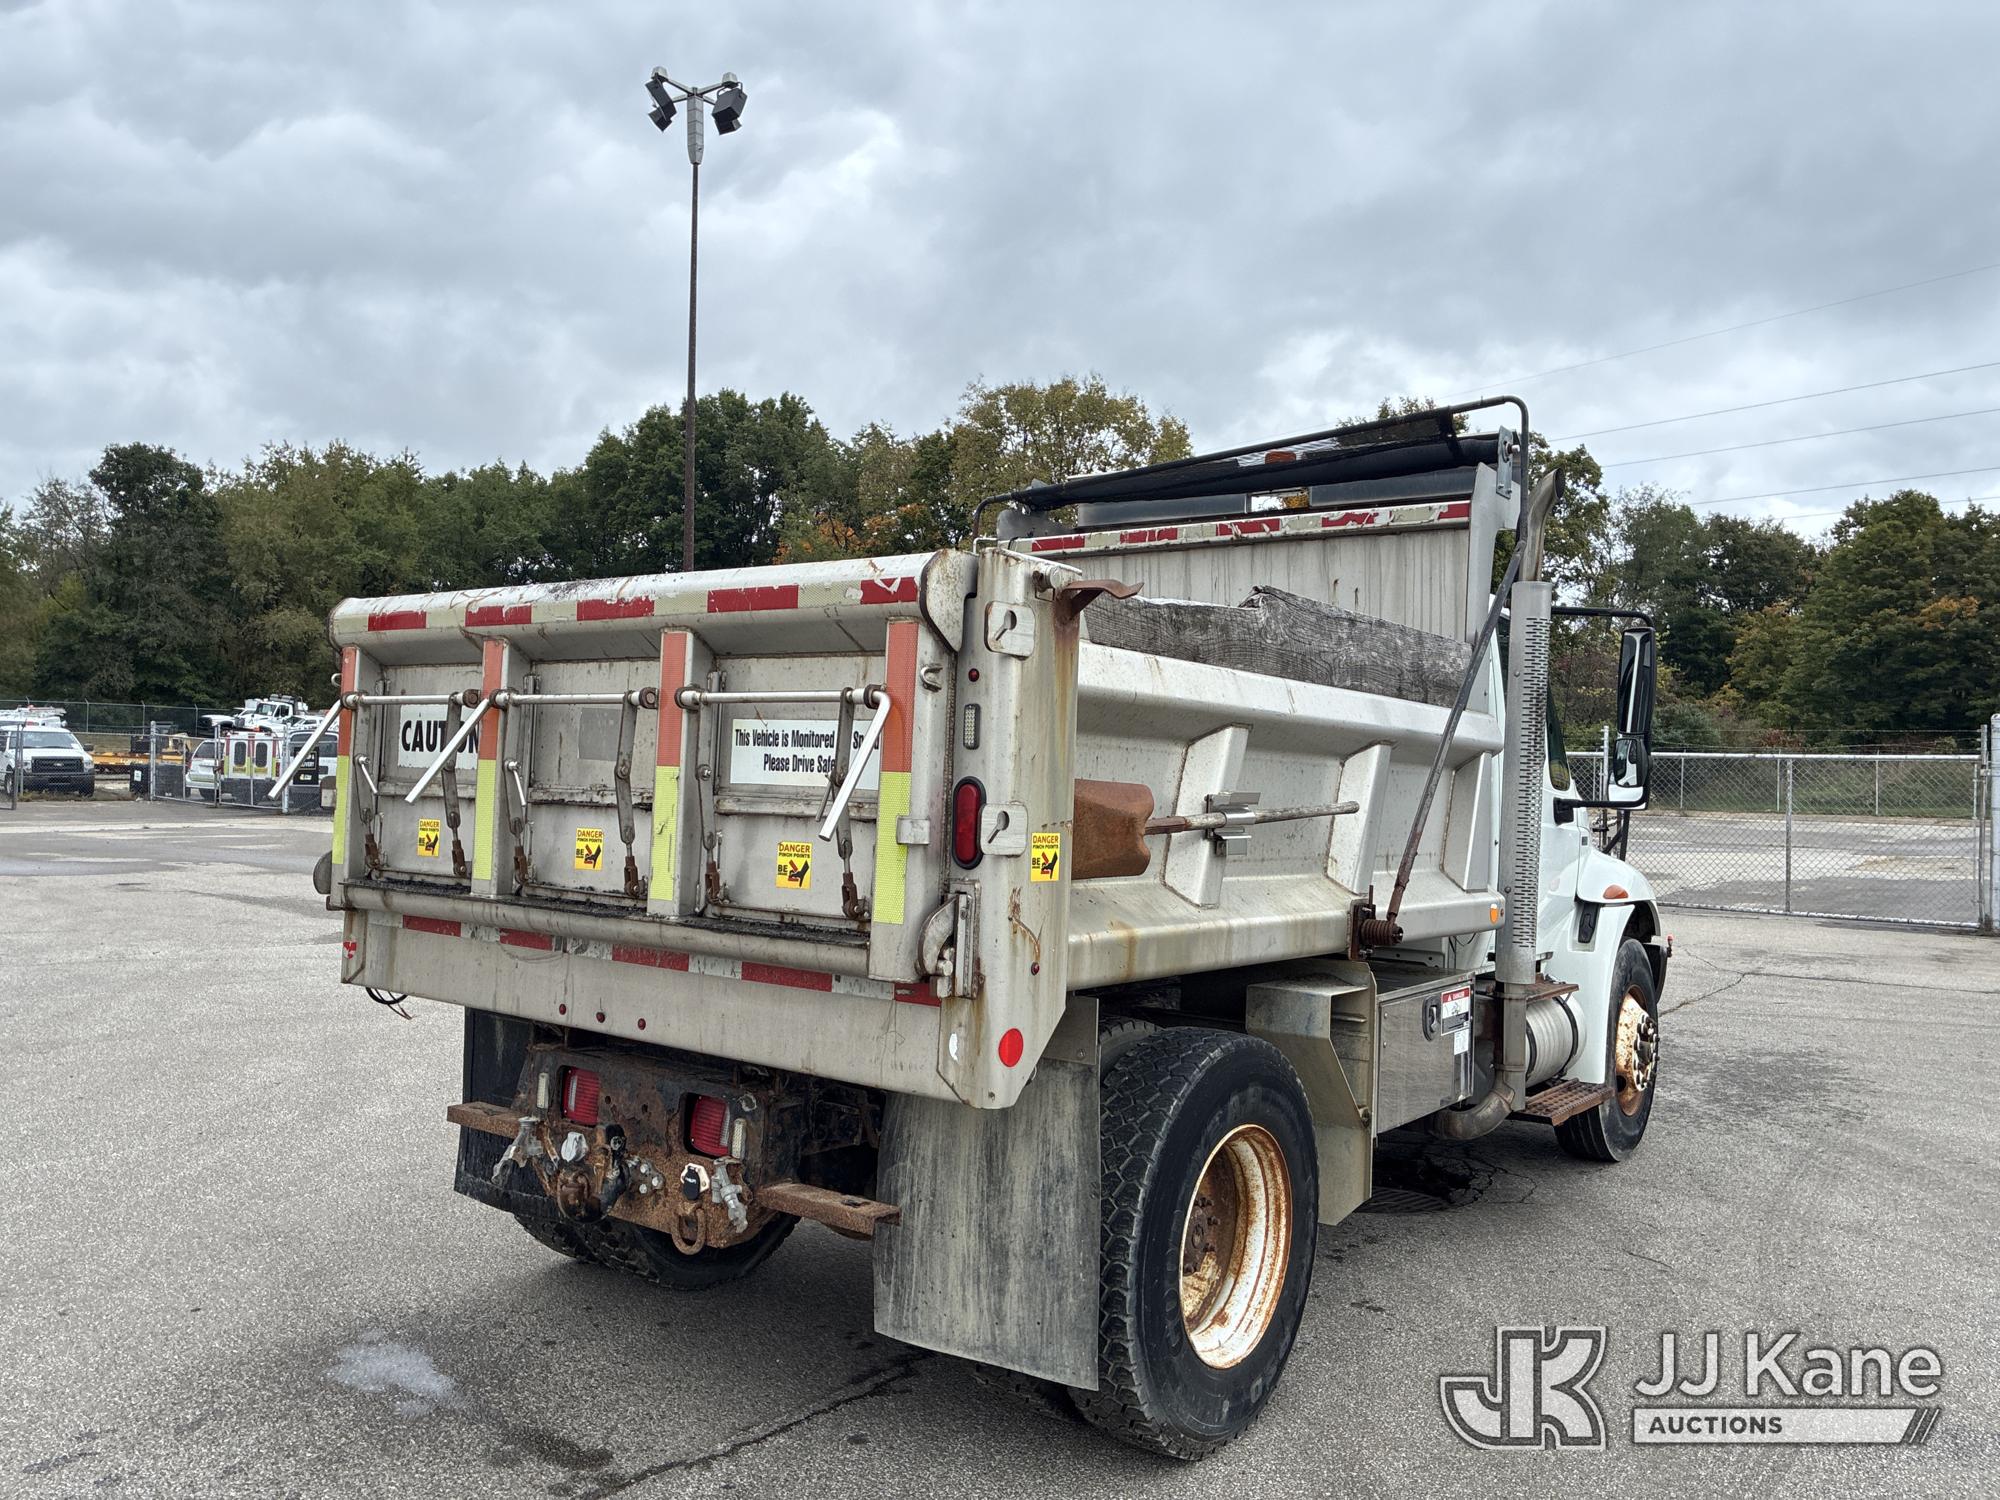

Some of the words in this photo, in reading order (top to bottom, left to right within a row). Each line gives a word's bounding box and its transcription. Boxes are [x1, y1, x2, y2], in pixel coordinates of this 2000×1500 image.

[735, 729, 750, 747] This
[752, 729, 779, 747] Vehicle
[781, 730, 789, 748] is
[791, 730, 835, 749] Monitored
[763, 753, 790, 772] Please
[792, 755, 815, 773] Drive
[577, 830, 603, 839] DANGER
[1032, 835, 1059, 844] DANGER
[778, 843, 811, 853] DANGER
[1032, 857, 1041, 866] BE
[777, 864, 788, 873] BE
